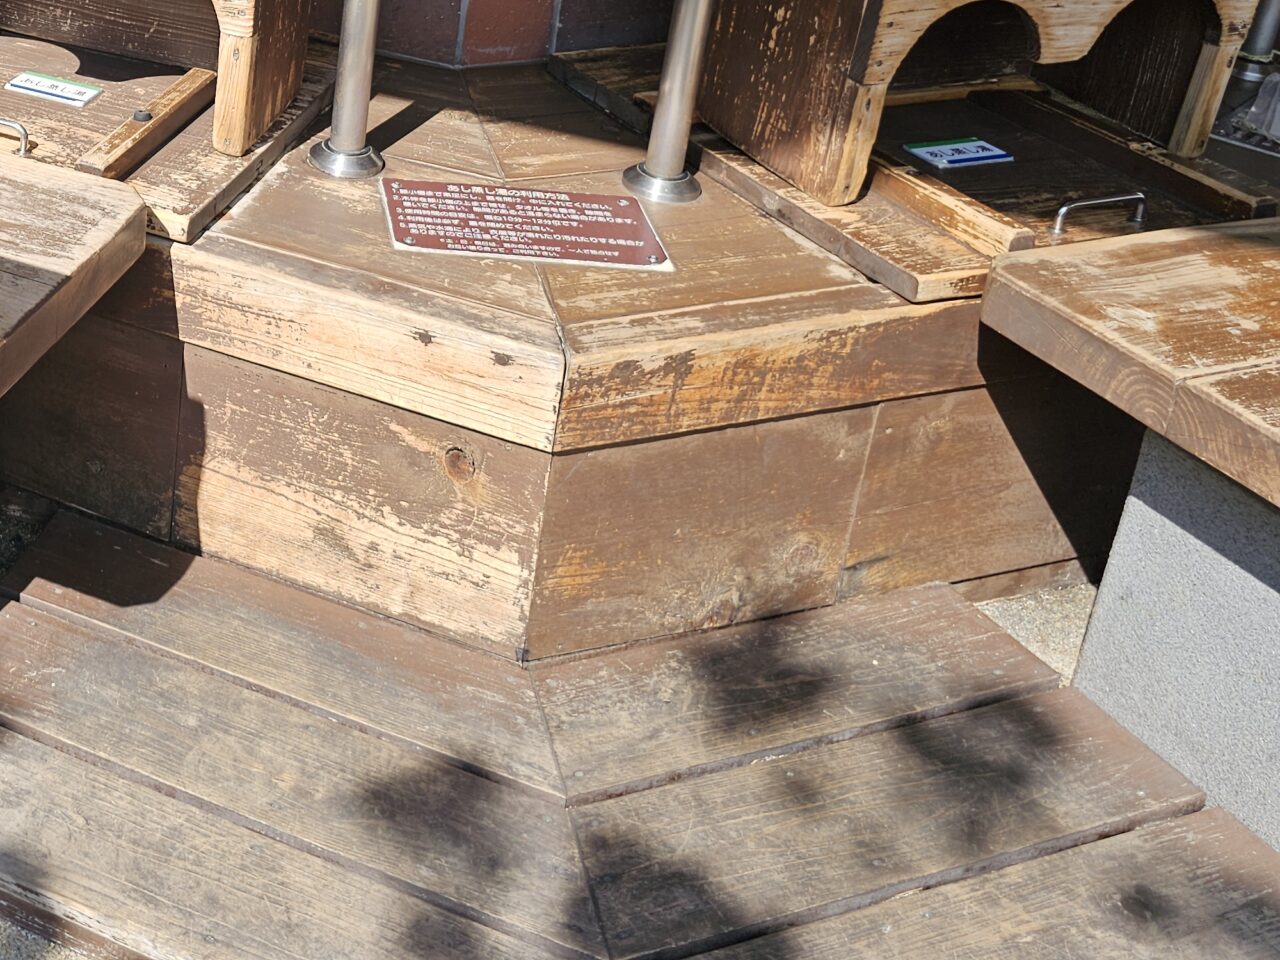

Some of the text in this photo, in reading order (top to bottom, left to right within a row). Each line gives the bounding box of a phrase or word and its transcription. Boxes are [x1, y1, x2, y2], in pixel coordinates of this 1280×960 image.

[447, 184, 570, 200] あし蒸し湯の利用方法
